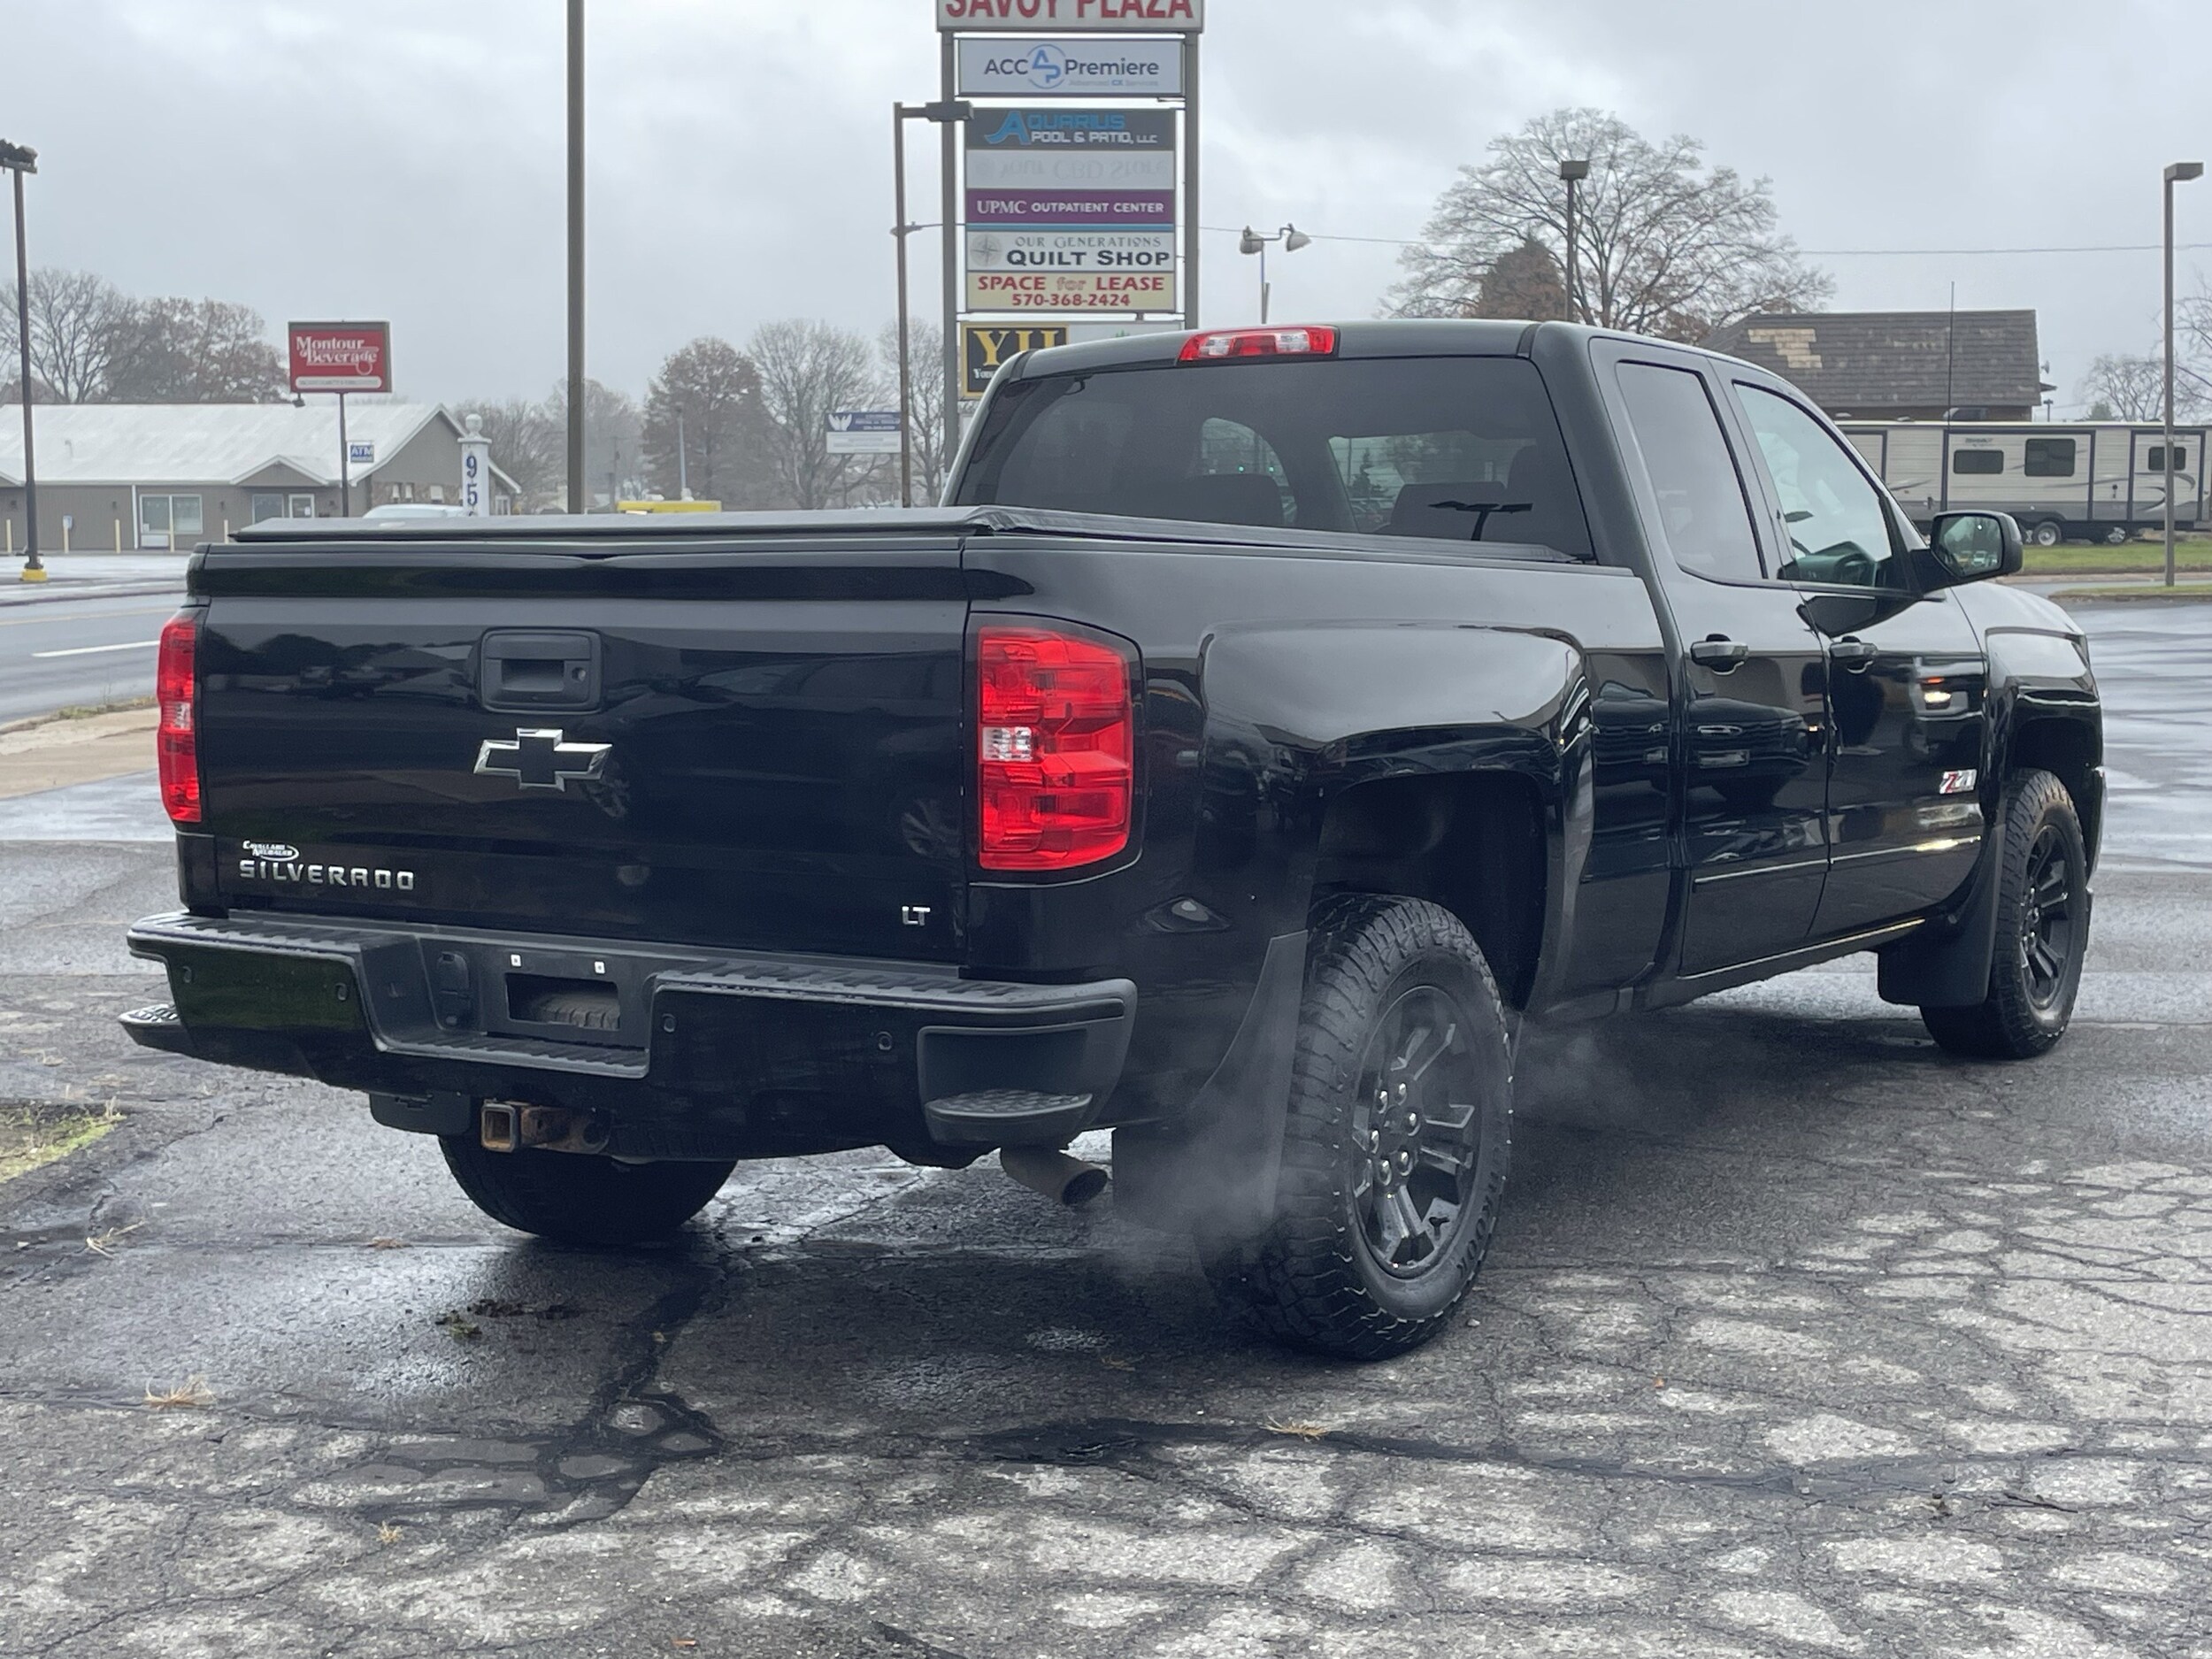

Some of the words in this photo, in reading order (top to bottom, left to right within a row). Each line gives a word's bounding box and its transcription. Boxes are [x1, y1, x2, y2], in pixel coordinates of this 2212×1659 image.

[946, 0, 1059, 18] SAVOY
[1076, 0, 1194, 19] PLAZA
[983, 58, 1029, 75] ACC
[1064, 58, 1160, 75] Premiere
[984, 111, 1126, 145] AQUARIUS
[1031, 132, 1071, 143] POOL
[1073, 132, 1086, 142] &
[1136, 134, 1159, 144] LLC
[976, 200, 1027, 214] UPMC
[1031, 202, 1110, 213] OUTPATIENT
[1112, 202, 1164, 213] CENTER
[1014, 236, 1046, 247] OUR
[1054, 236, 1162, 248] GENERATIONS
[1006, 250, 1087, 266] QUILT
[1096, 250, 1171, 266] SHOP
[977, 276, 1047, 291] SPACE
[1056, 276, 1087, 291] for
[1095, 276, 1165, 291] LEASE
[1011, 293, 1131, 307] 570-368-2424
[296, 335, 365, 351] Montour
[350, 446, 374, 456] ATM
[239, 859, 414, 891] SILVERADO
[901, 905, 932, 926] LT
